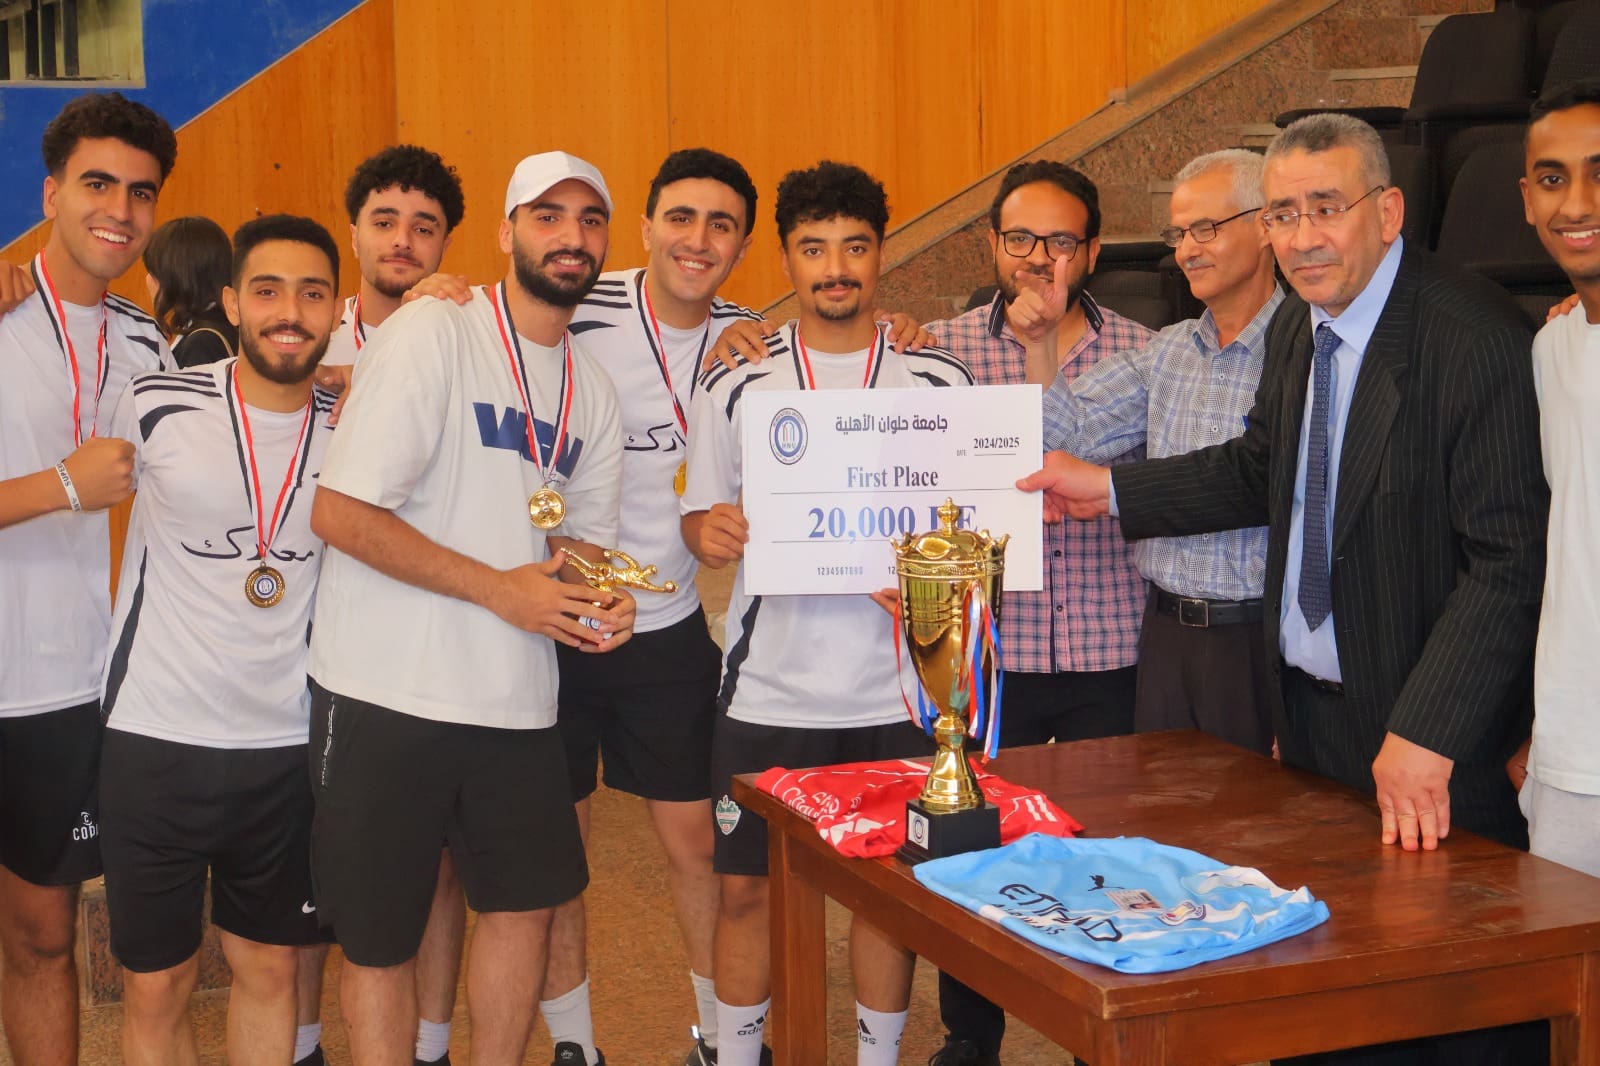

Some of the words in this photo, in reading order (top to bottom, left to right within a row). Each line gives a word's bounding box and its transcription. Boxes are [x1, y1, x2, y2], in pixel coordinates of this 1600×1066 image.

[835, 413, 875, 435] الأهلية
[878, 415, 909, 435] حلوان
[912, 414, 948, 433] جامعة
[973, 437, 1020, 449] 2024/2025
[847, 466, 888, 488] First
[893, 465, 939, 487] Place
[808, 506, 916, 544] 20,000
[887, 565, 897, 575] 12
